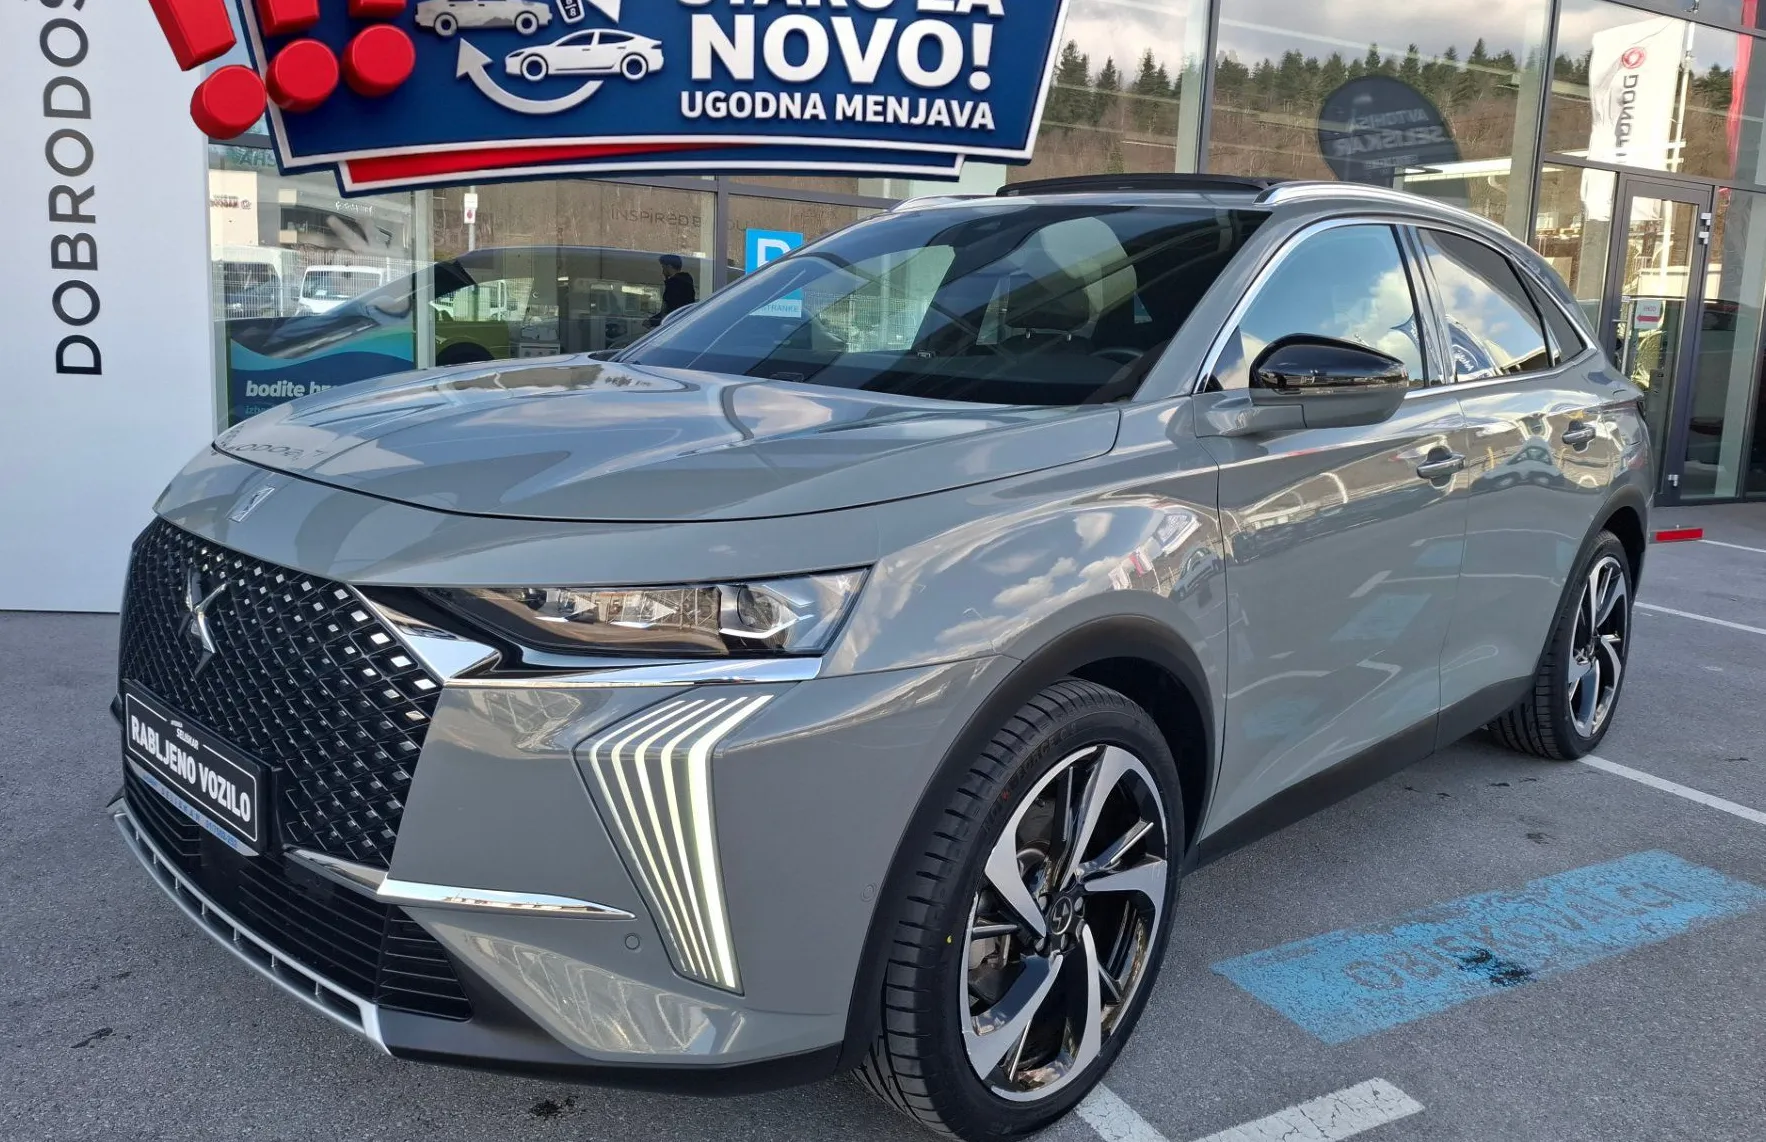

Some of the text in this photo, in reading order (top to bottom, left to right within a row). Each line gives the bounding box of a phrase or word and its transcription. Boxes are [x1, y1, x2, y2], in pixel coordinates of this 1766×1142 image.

[245, 380, 305, 397] bodite
[131, 715, 251, 822] RABLJENO VOZILO
